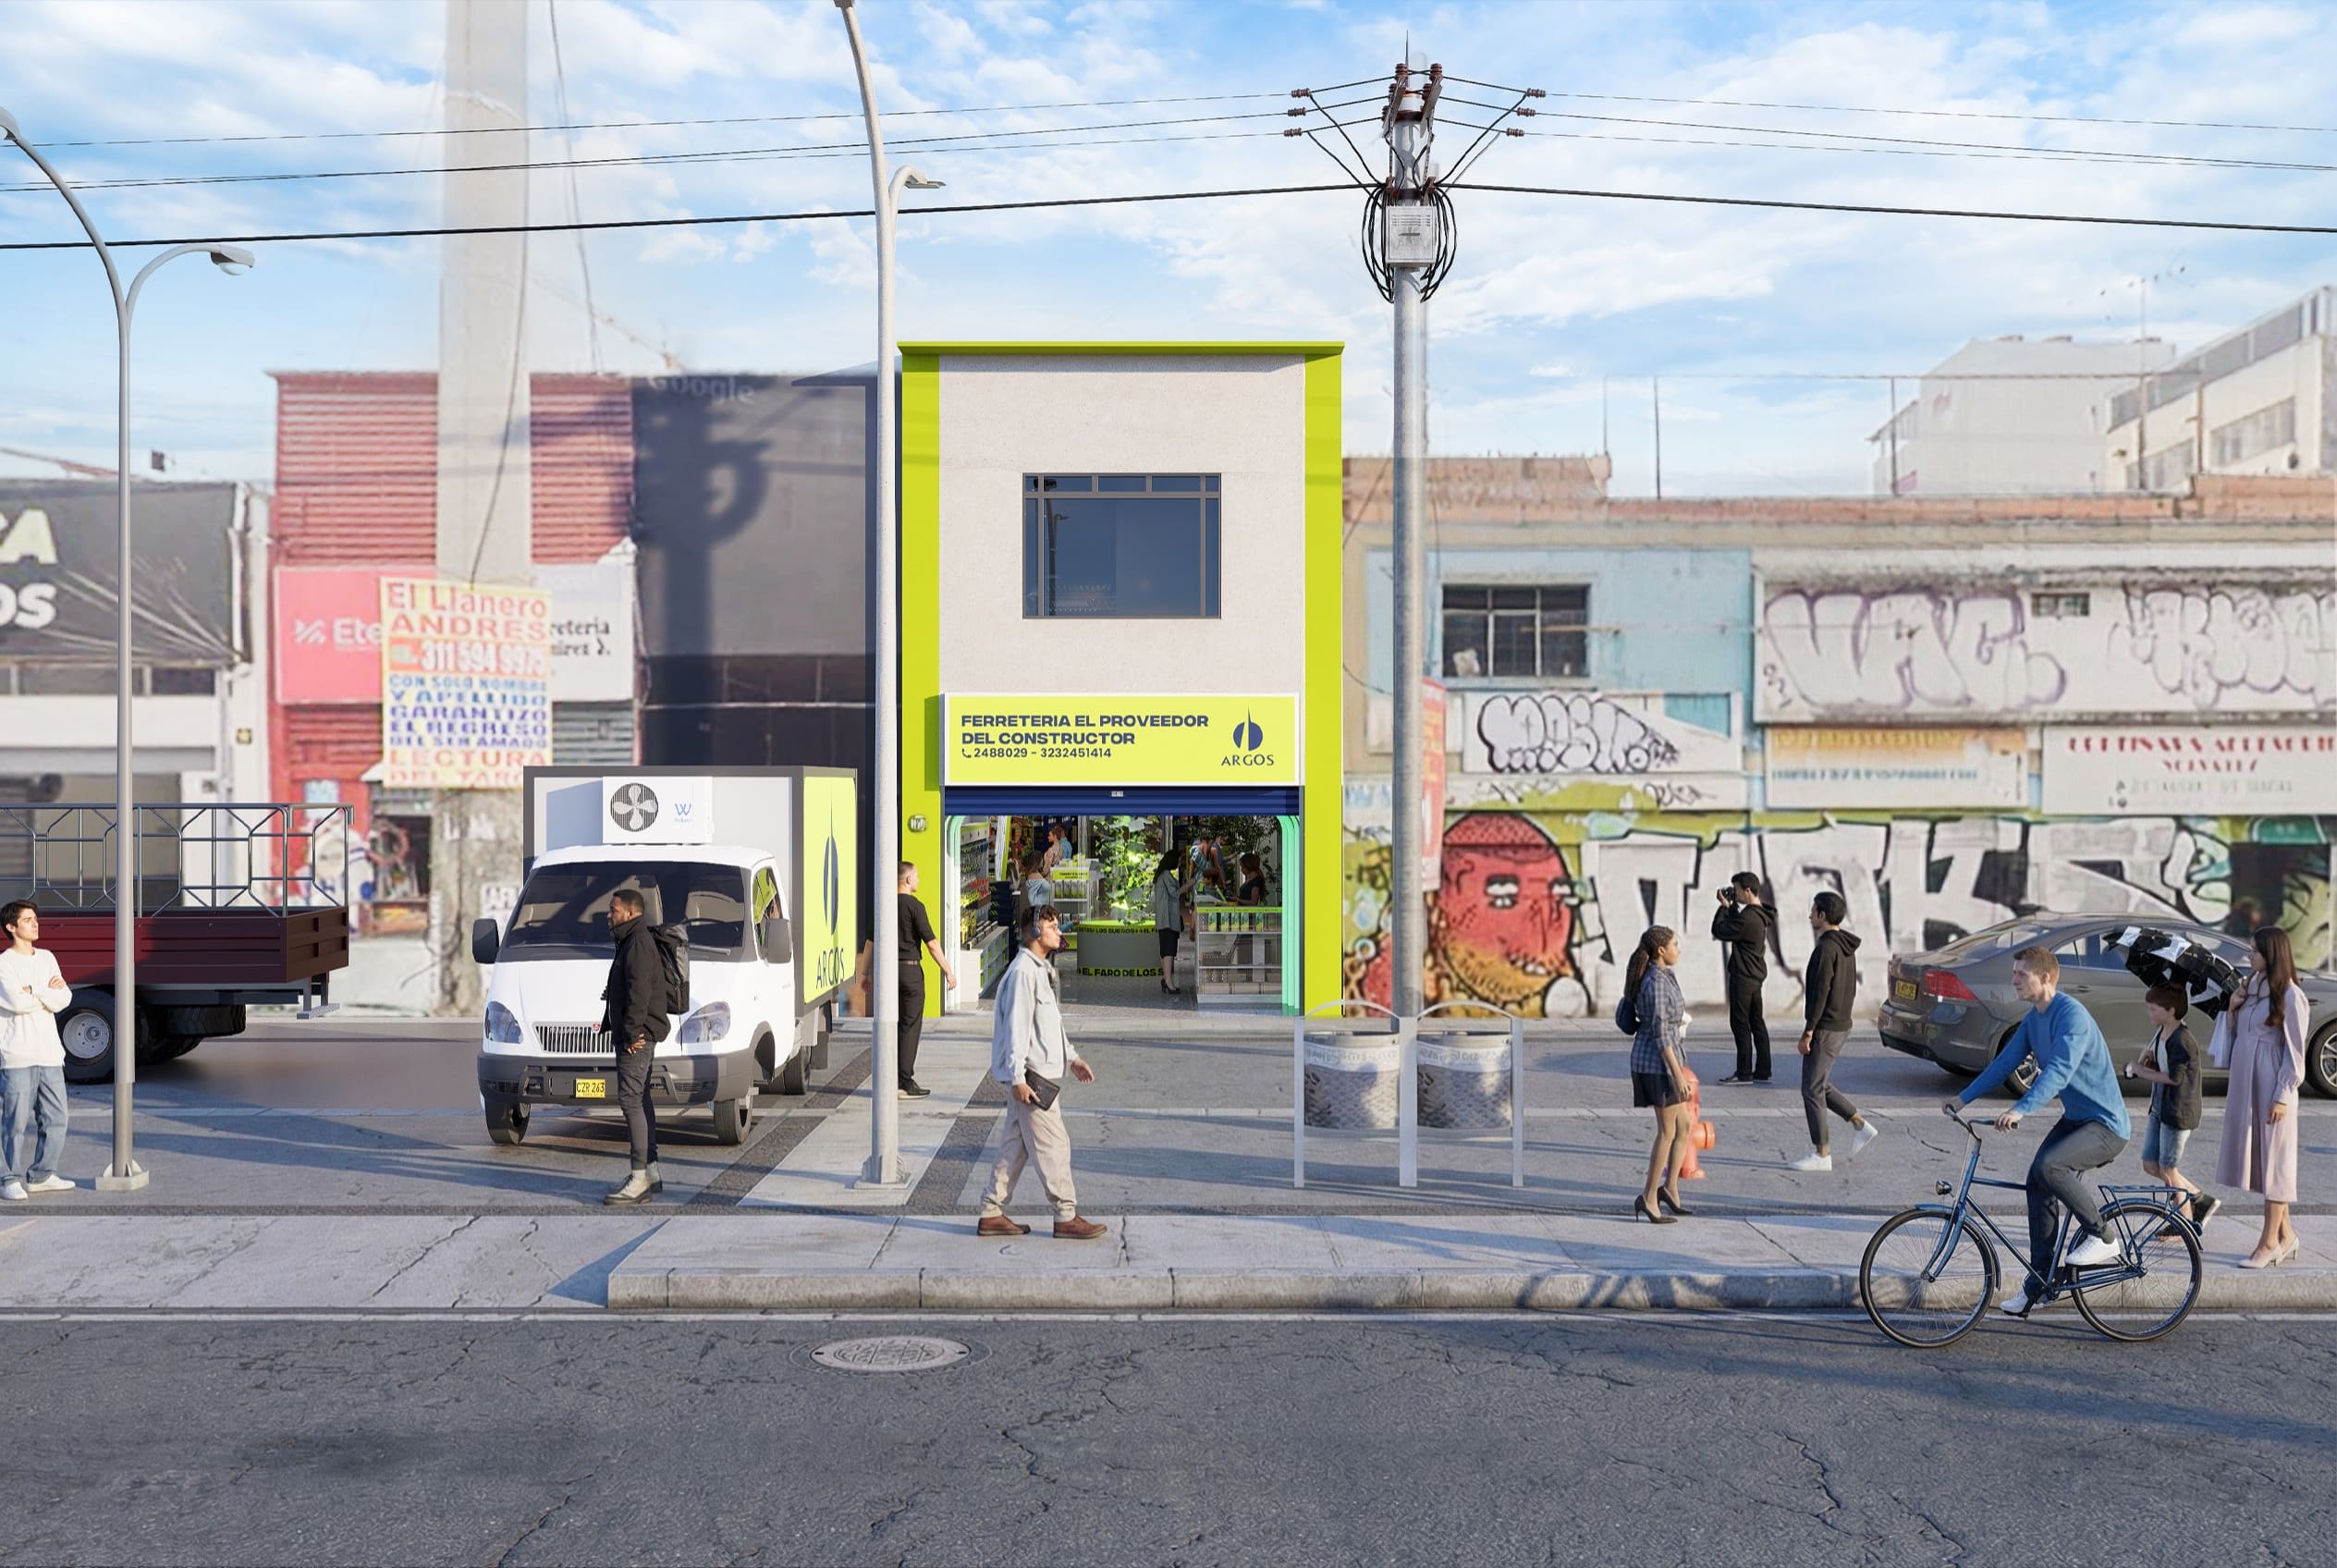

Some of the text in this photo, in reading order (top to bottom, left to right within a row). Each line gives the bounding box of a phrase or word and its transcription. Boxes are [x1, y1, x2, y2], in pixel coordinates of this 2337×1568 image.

[0, 508, 57, 563] A
[387, 582, 546, 619] El Llanero
[390, 613, 547, 641] ANDRES
[389, 675, 425, 688] CON
[390, 706, 546, 721] GARANTIZO
[390, 721, 415, 733] EL
[961, 715, 1209, 728] FERRETERIA EL PROVEEDOR
[961, 732, 1135, 745] DEL CONSTRUCTOR
[390, 750, 546, 767] LECTURA
[973, 747, 1028, 758] 2488029
[1040, 747, 1112, 758] 3232451414
[1220, 753, 1275, 766] ARGOS
[815, 946, 844, 990] ARGOS
[1094, 968, 1122, 977] FARO
[1122, 968, 1135, 977] DE
[1136, 968, 1156, 977] LOS
